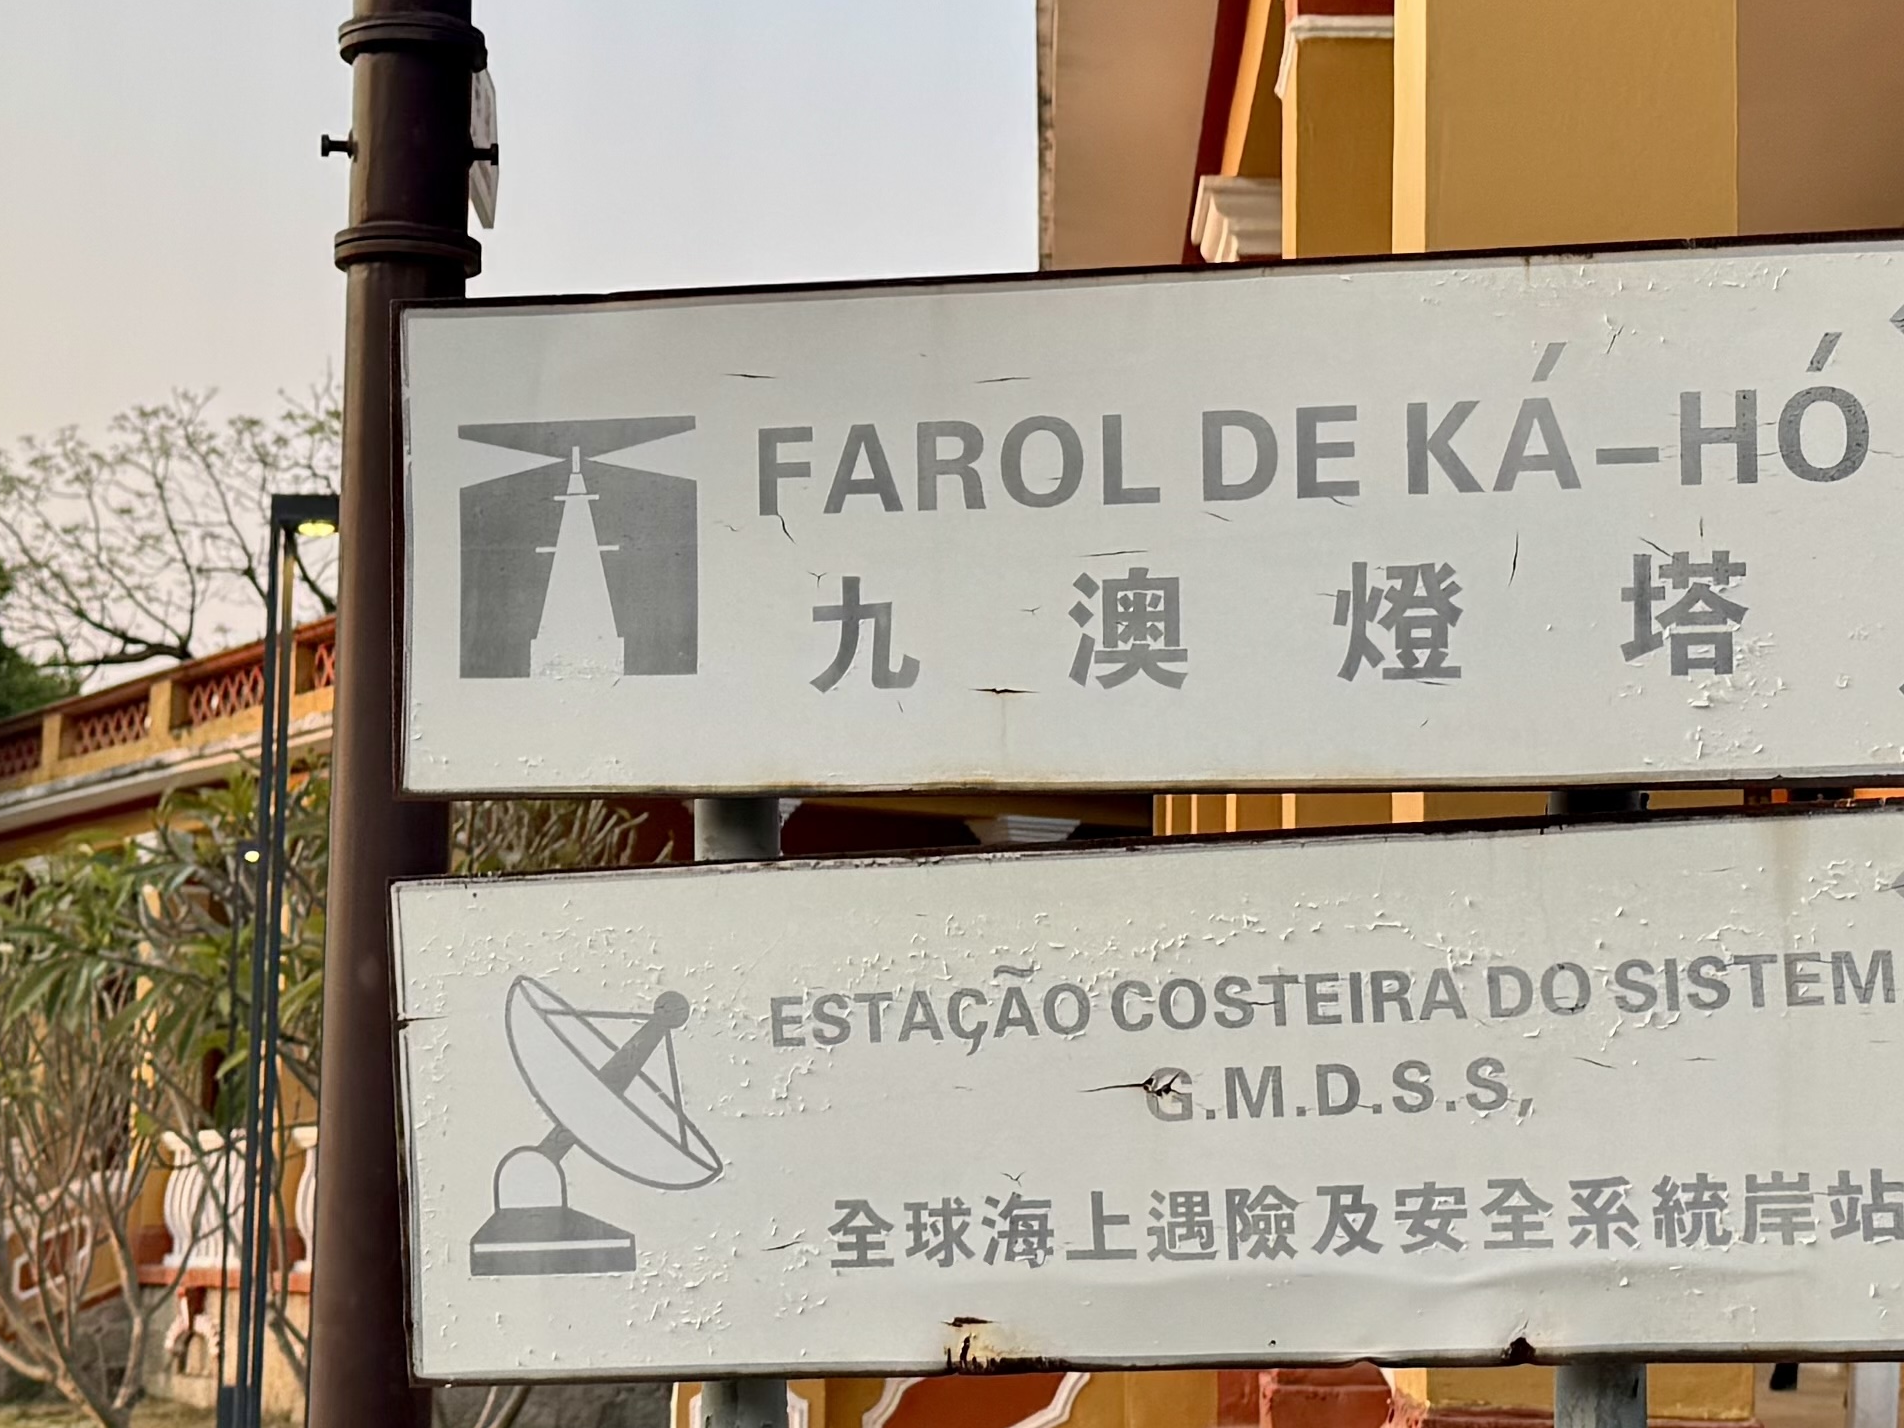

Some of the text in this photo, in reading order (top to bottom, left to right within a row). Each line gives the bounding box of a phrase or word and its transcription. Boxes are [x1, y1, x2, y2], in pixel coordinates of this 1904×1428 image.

[757, 414, 1162, 517] FAROL
[1201, 404, 1361, 503] DE
[808, 549, 1750, 694] 九澳燈塔
[769, 964, 1091, 1057] ESTAÇÃO
[1109, 966, 1468, 1032] COSTEIRA
[1486, 961, 1593, 1019] DO
